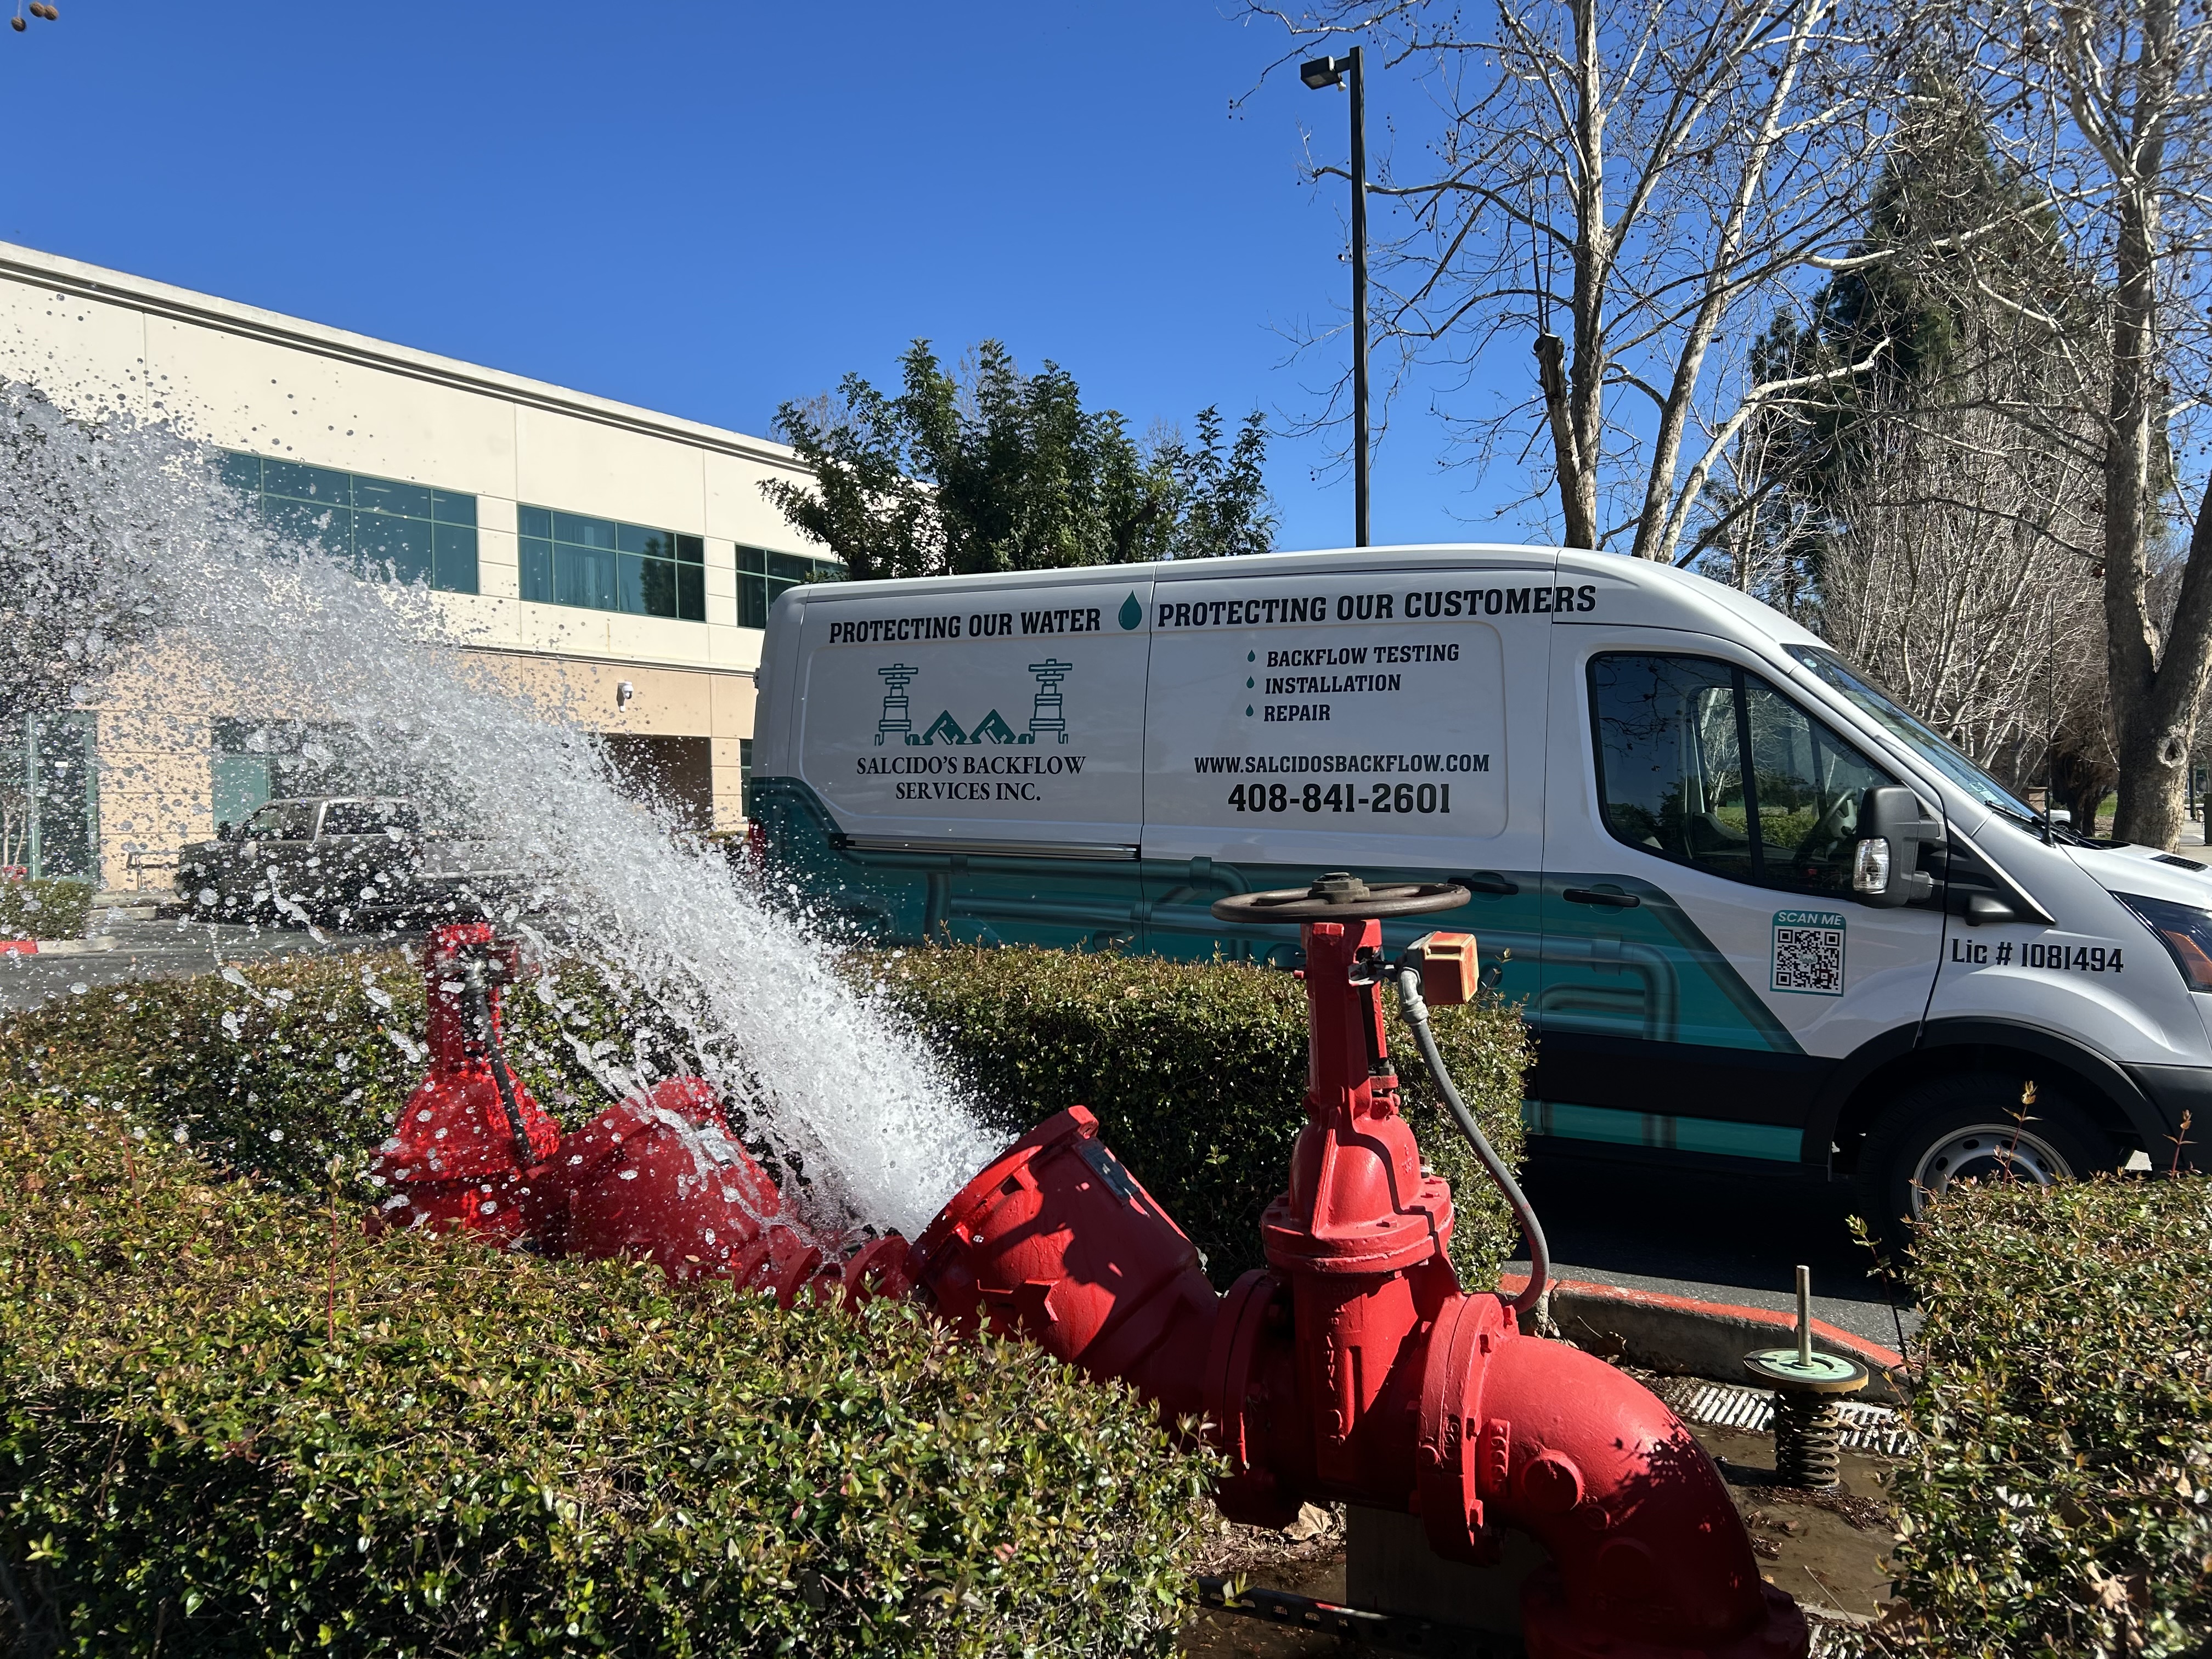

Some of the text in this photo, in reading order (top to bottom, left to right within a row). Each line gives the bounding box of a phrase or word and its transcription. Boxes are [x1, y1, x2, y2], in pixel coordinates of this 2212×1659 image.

[1158, 585, 1596, 627] PROTECTING OUR CUSTOMERS
[829, 608, 1101, 644] PROTECTING OUR WATER
[1267, 644, 1459, 668] BACKFLOW TESTING
[1265, 674, 1401, 695] INSTALLATION
[1263, 704, 1330, 722] REPAIR
[856, 755, 1087, 775] SALCIDO'S BACKFLOW
[1194, 754, 1489, 773] WWW.SALCIDOSBACKFLOW.COM
[895, 782, 1041, 801] SERVICES INC.
[1228, 783, 1450, 814] 408-841-2601
[1778, 912, 1842, 926] SCAN ME
[1951, 938, 2124, 973] Lic # 1081494
